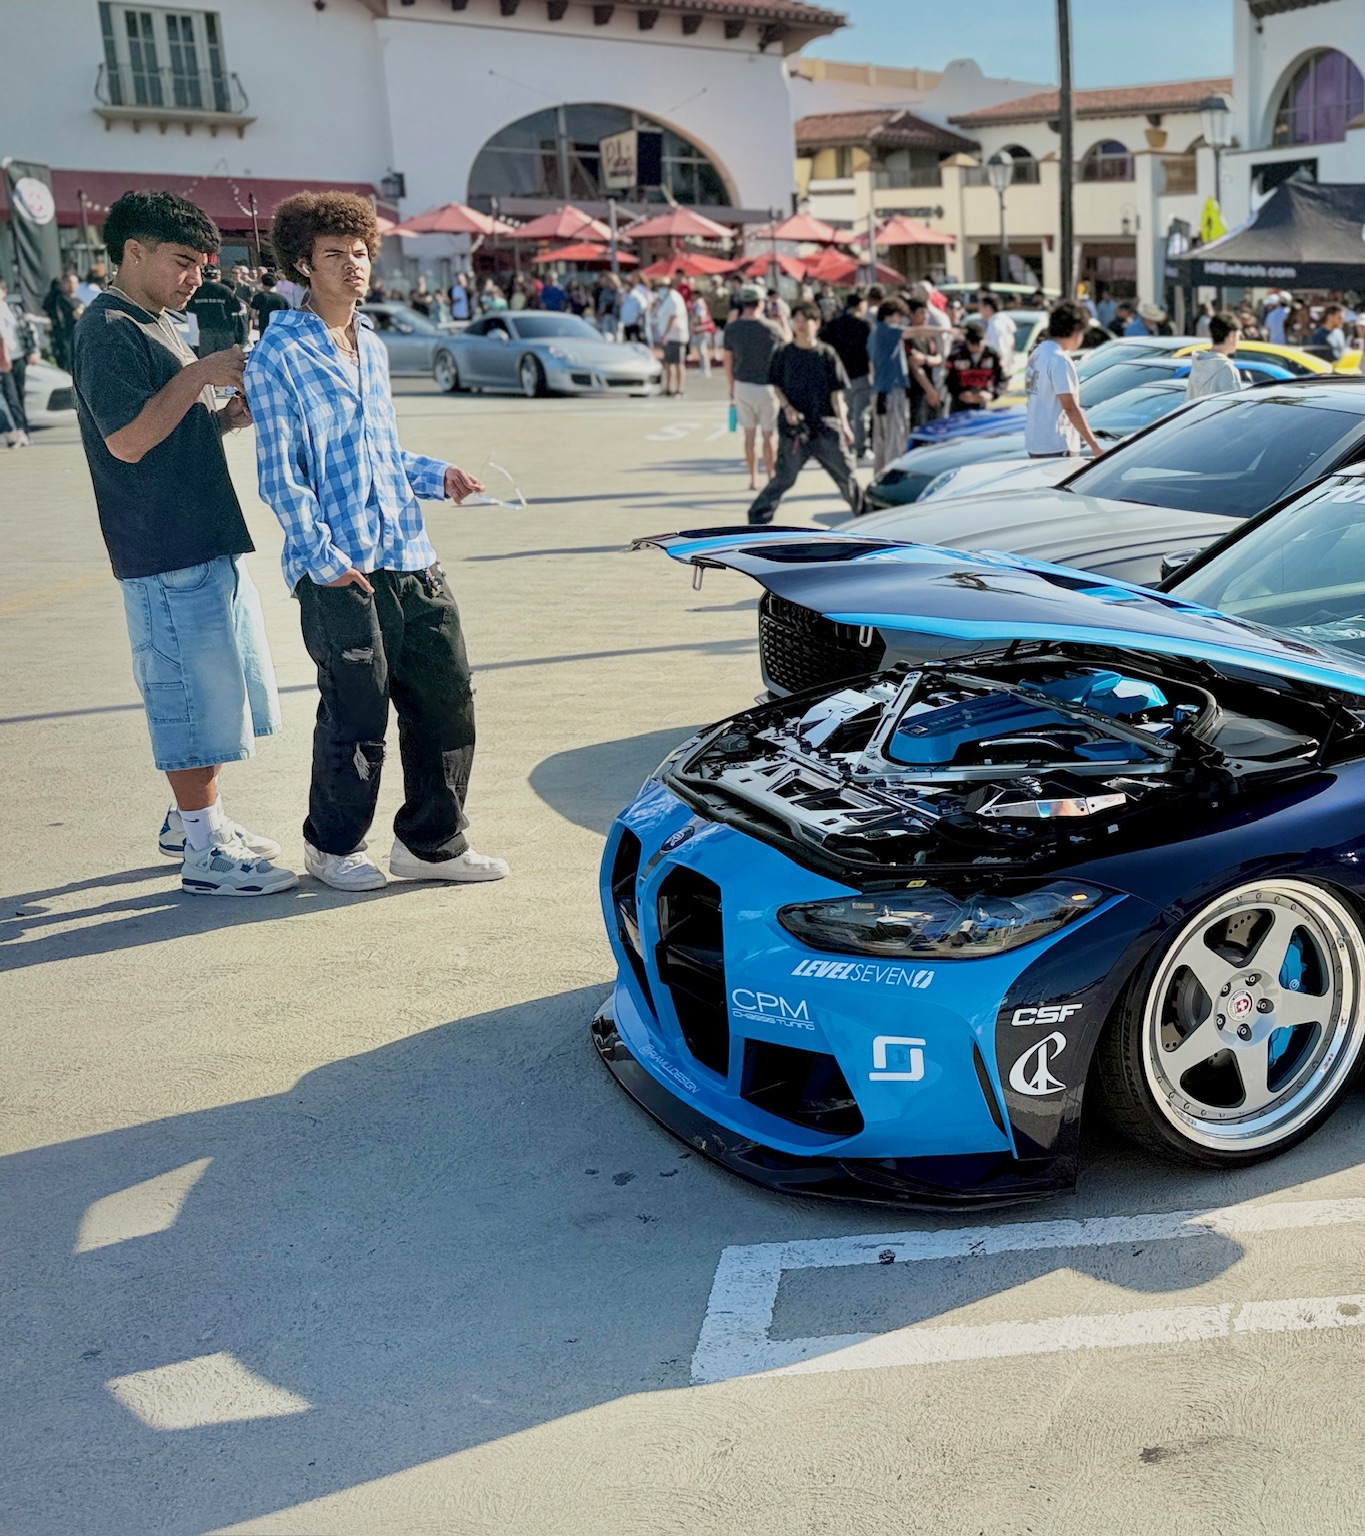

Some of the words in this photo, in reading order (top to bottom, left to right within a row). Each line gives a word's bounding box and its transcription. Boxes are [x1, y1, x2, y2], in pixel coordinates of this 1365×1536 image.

[732, 988, 810, 1020] CPM
[1011, 1003, 1083, 1026] CSF
[1122, 1006, 1133, 1061] TIRES
